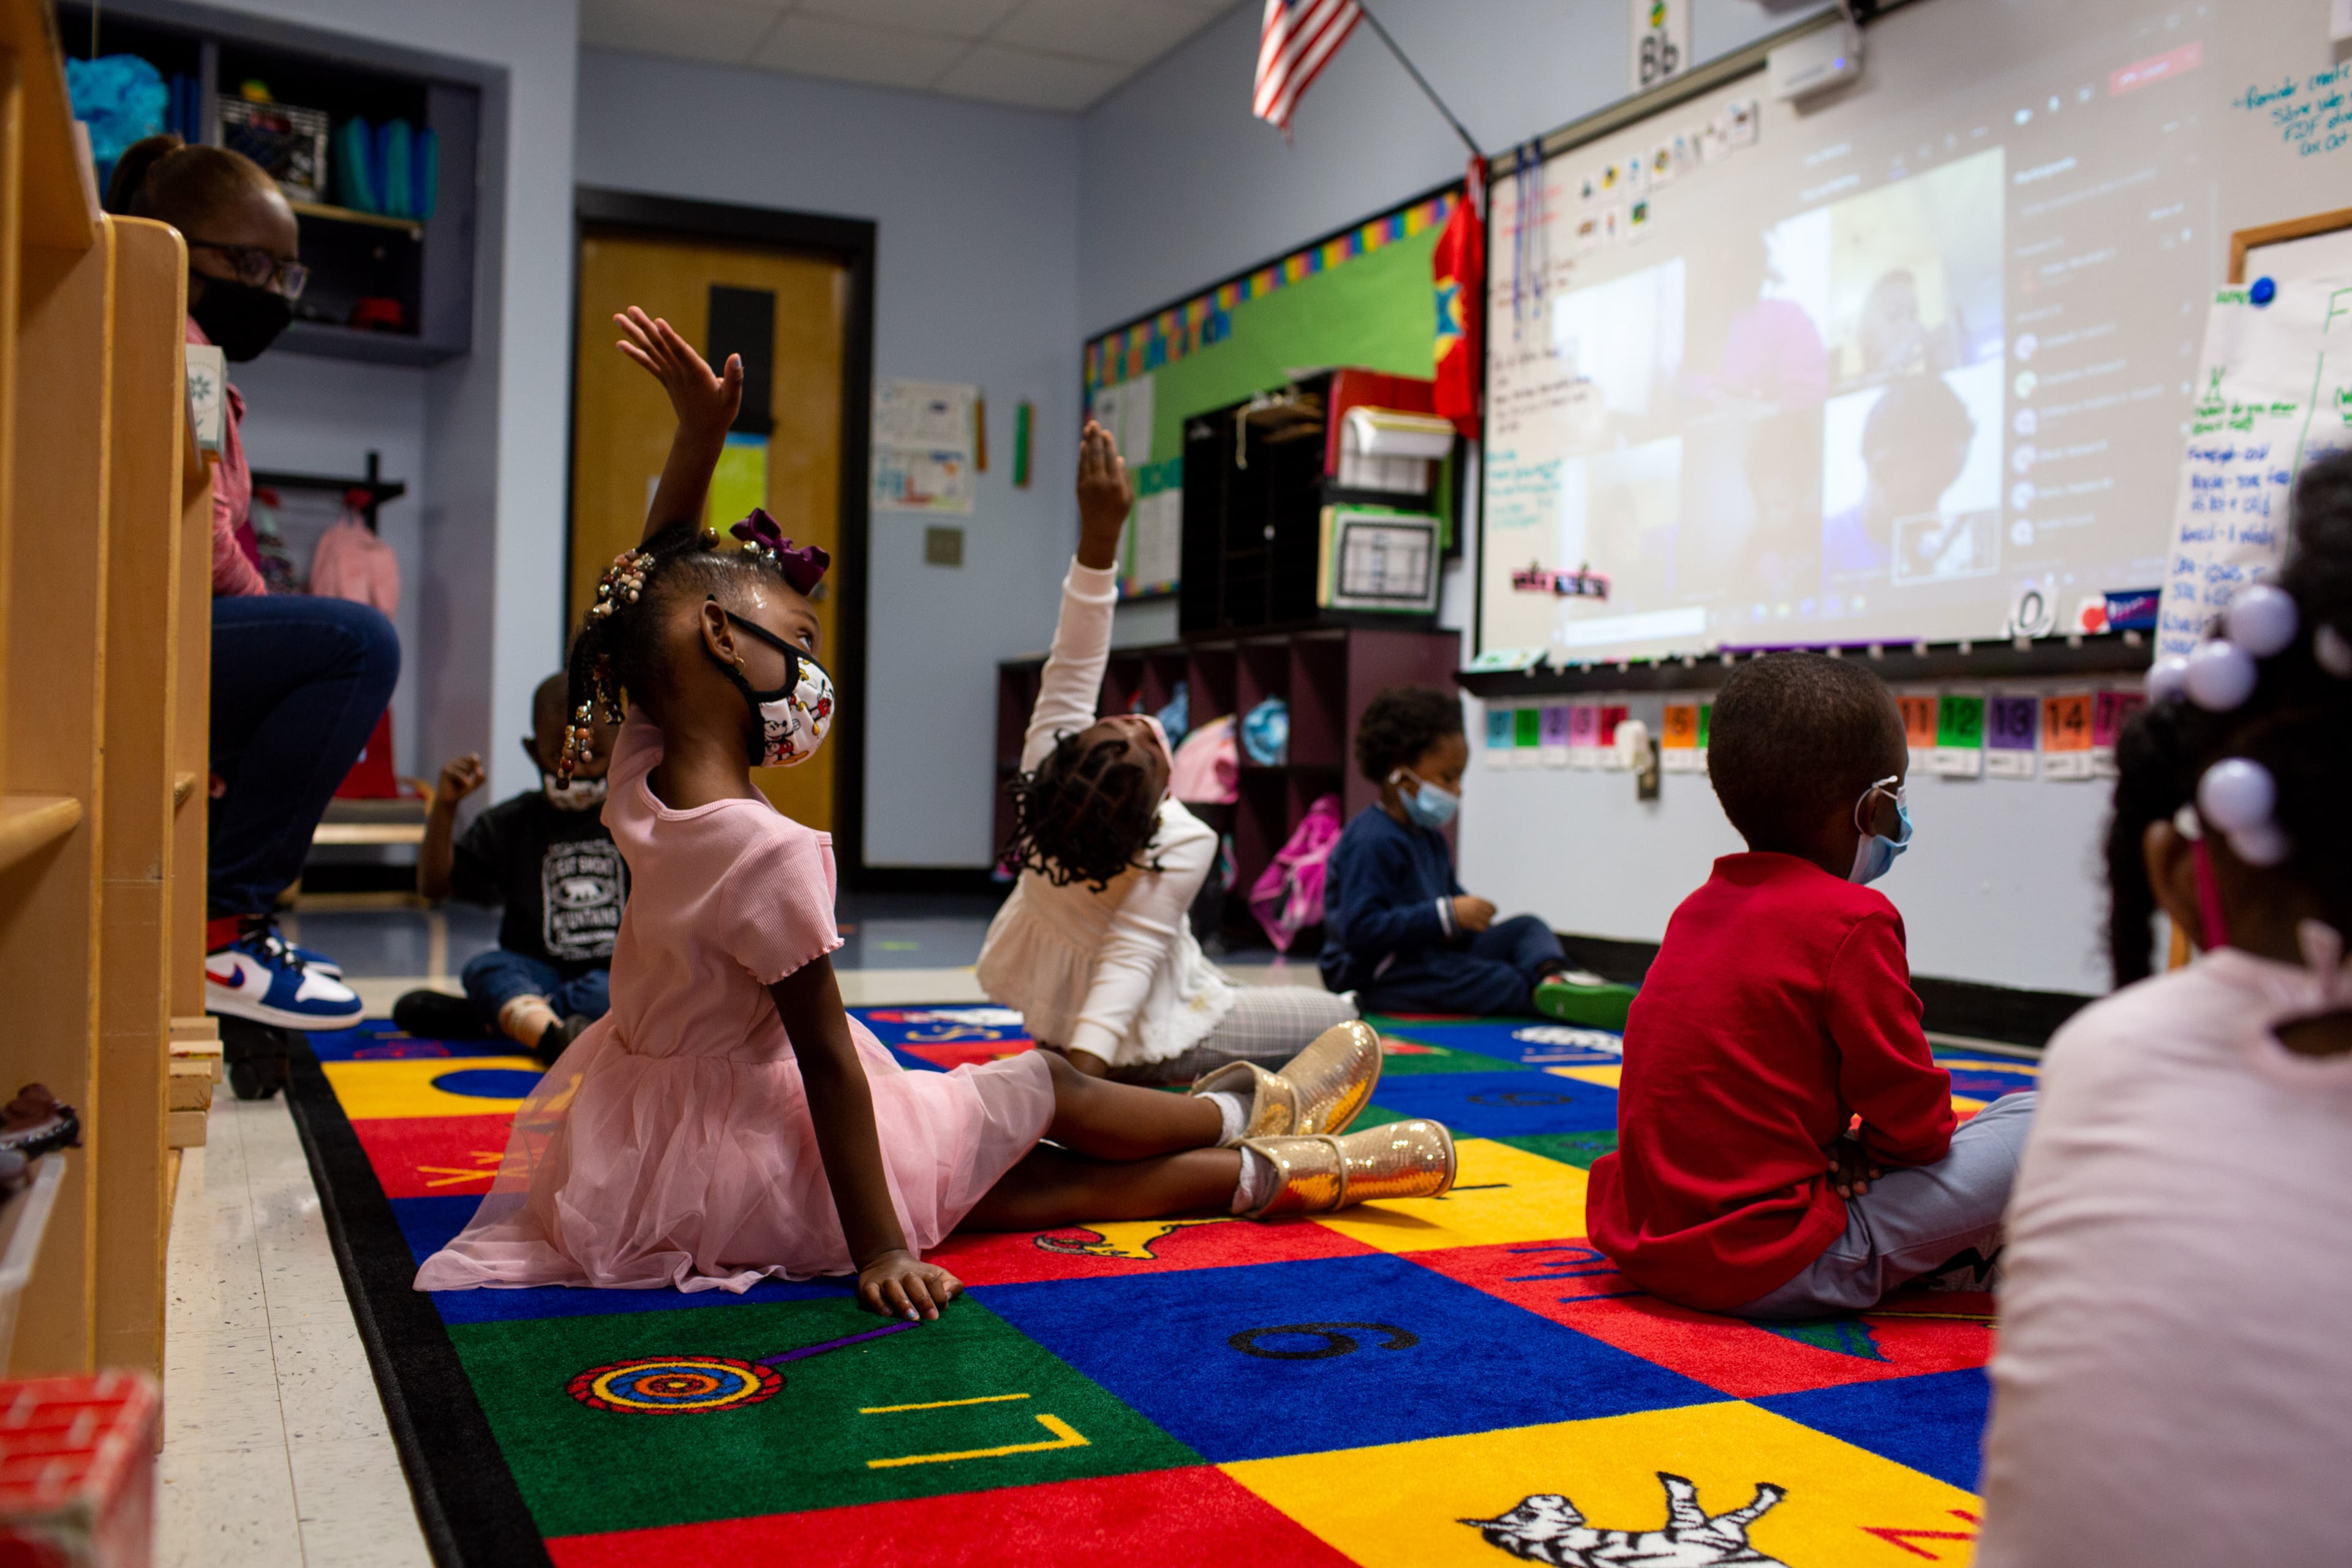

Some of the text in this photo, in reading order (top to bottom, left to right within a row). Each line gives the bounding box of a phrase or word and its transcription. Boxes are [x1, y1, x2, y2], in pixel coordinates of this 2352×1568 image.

[1945, 701, 1978, 737] 12
[1996, 701, 2030, 737] 13
[2051, 701, 2085, 737] 14
